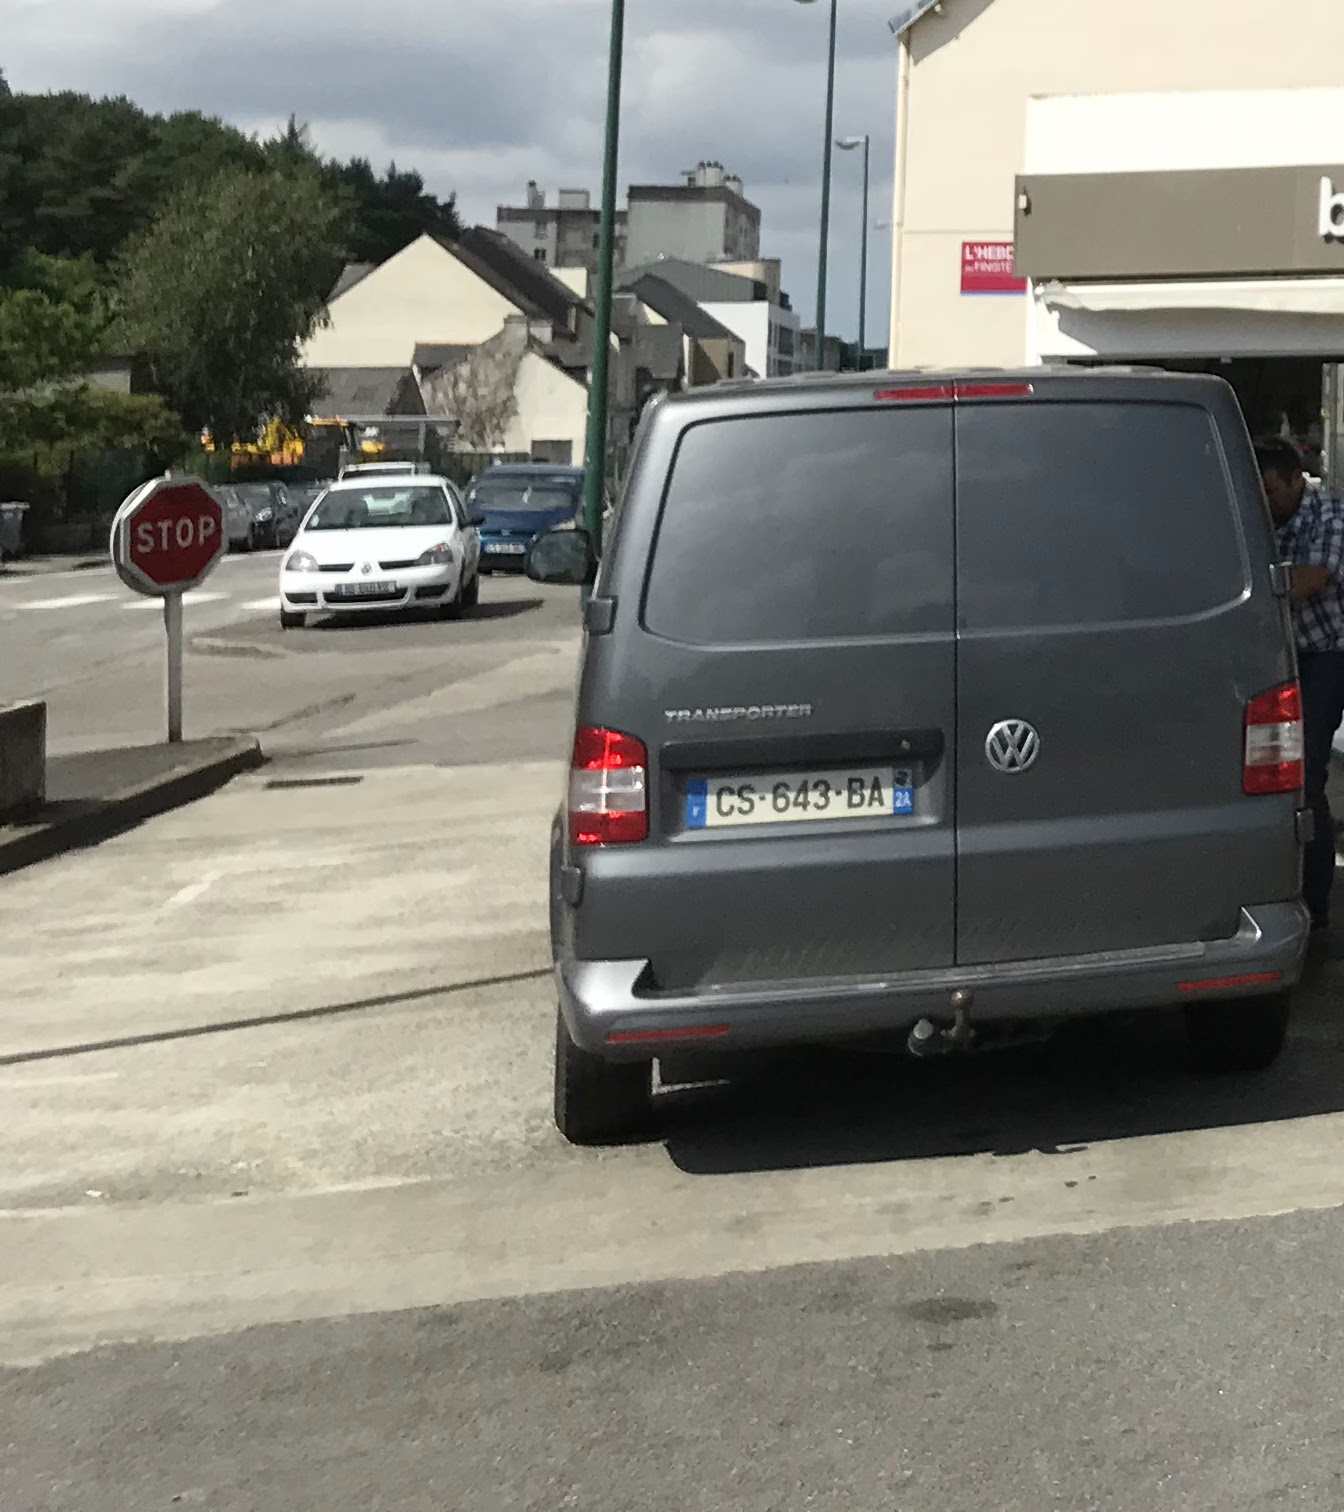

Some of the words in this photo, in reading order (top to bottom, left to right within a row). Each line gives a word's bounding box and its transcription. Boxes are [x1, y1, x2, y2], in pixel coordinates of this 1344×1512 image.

[136, 515, 216, 555] STOP
[664, 704, 813, 723] TRANSPORTER
[895, 791, 912, 808] 2A
